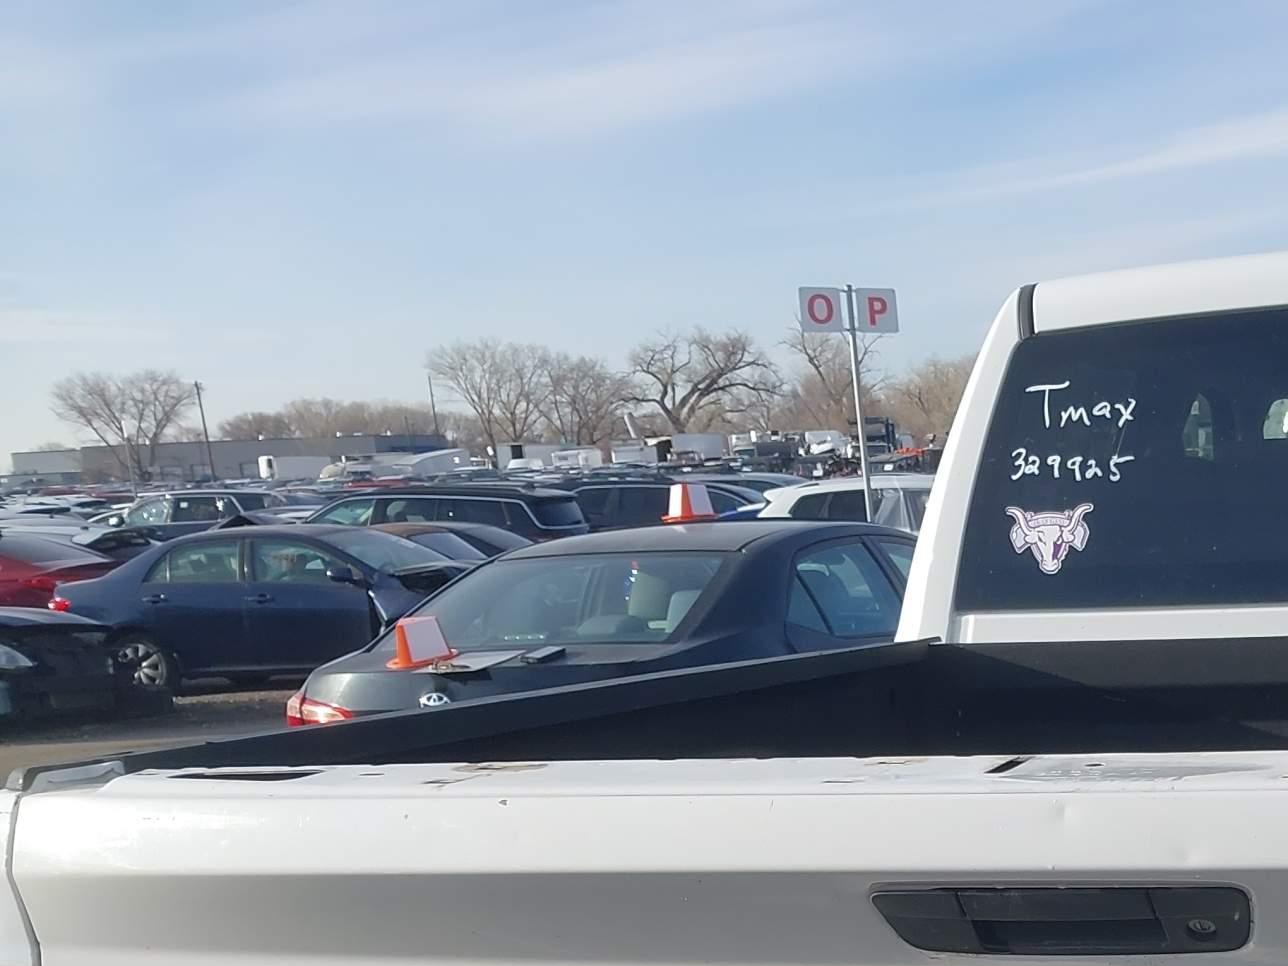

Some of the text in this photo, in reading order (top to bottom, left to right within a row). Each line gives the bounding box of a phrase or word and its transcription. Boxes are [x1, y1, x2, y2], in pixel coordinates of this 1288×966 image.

[807, 293, 834, 325] O
[867, 296, 888, 326] P
[1025, 380, 1137, 429] Tmax
[1010, 447, 1136, 482] 329925
